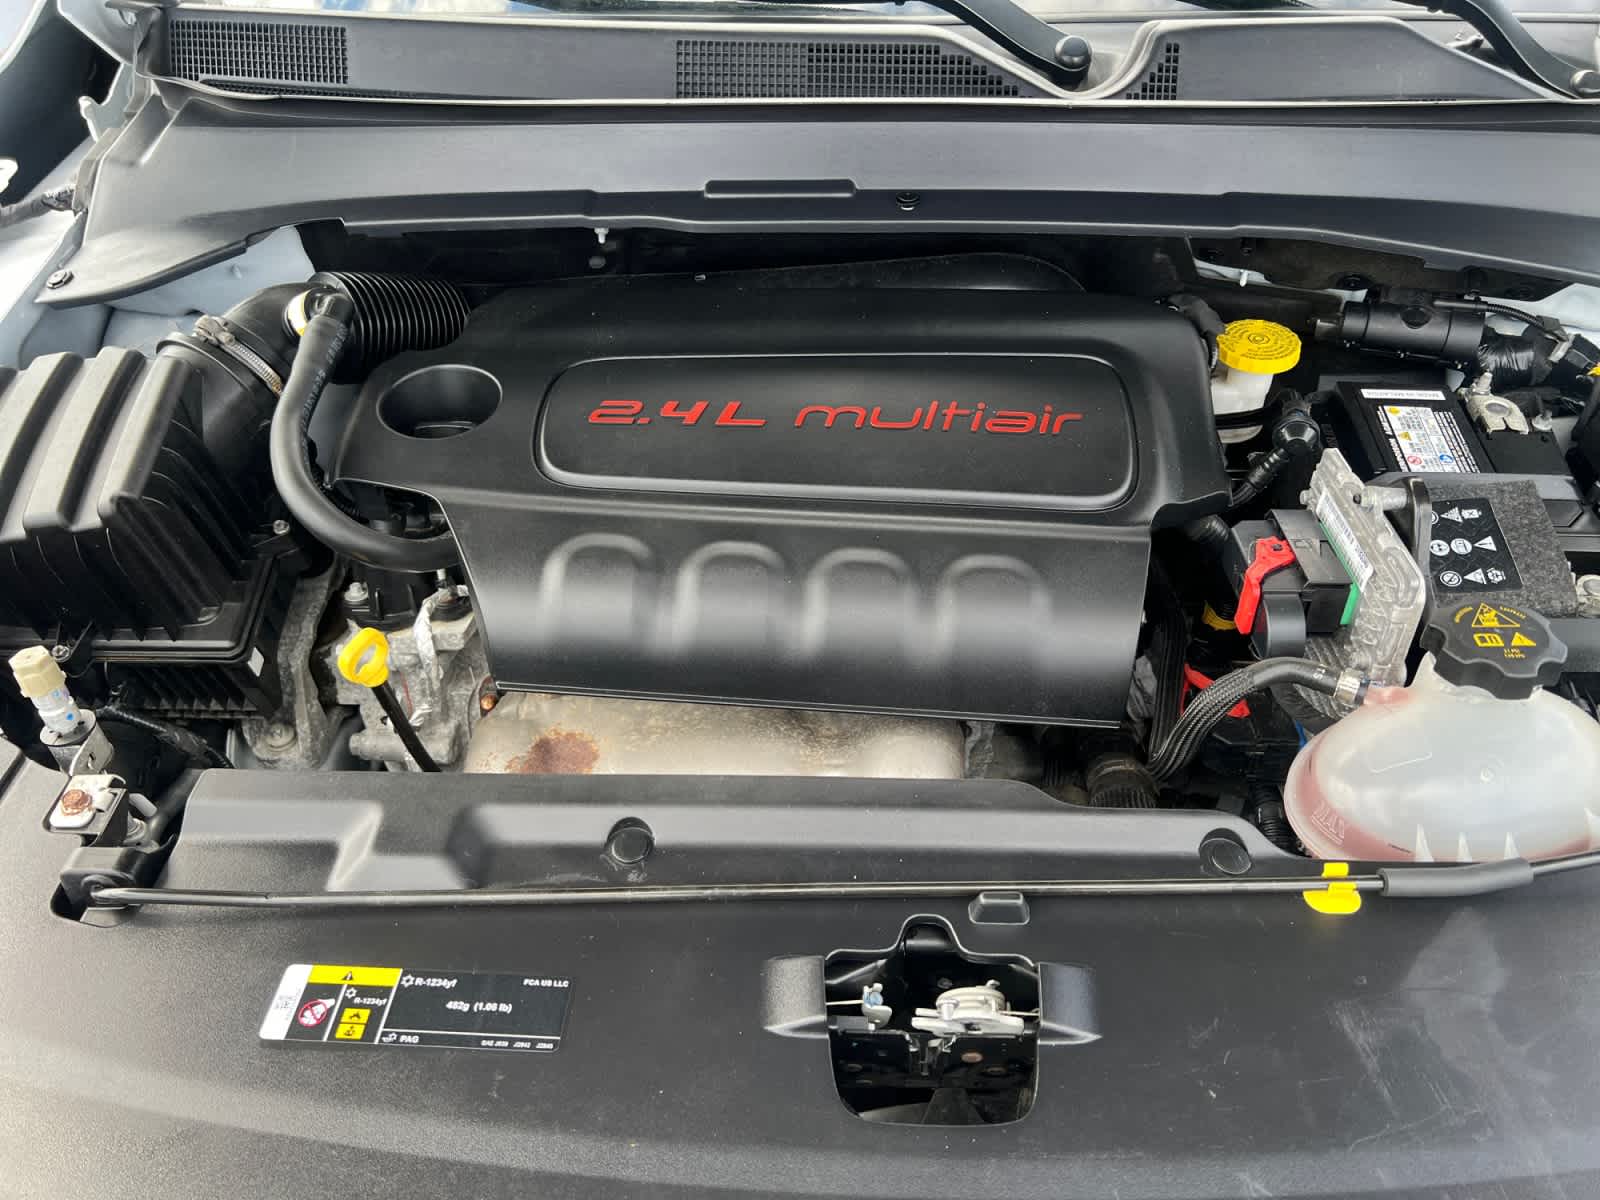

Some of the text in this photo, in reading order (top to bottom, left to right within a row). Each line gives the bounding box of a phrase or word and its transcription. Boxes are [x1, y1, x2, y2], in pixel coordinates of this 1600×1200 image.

[794, 400, 1084, 435] multiair
[415, 977, 458, 989] R-1234yf
[523, 978, 540, 987] FCA
[553, 979, 569, 987] LLC
[499, 1002, 512, 1014] lb)
[400, 1034, 420, 1044] PAG
